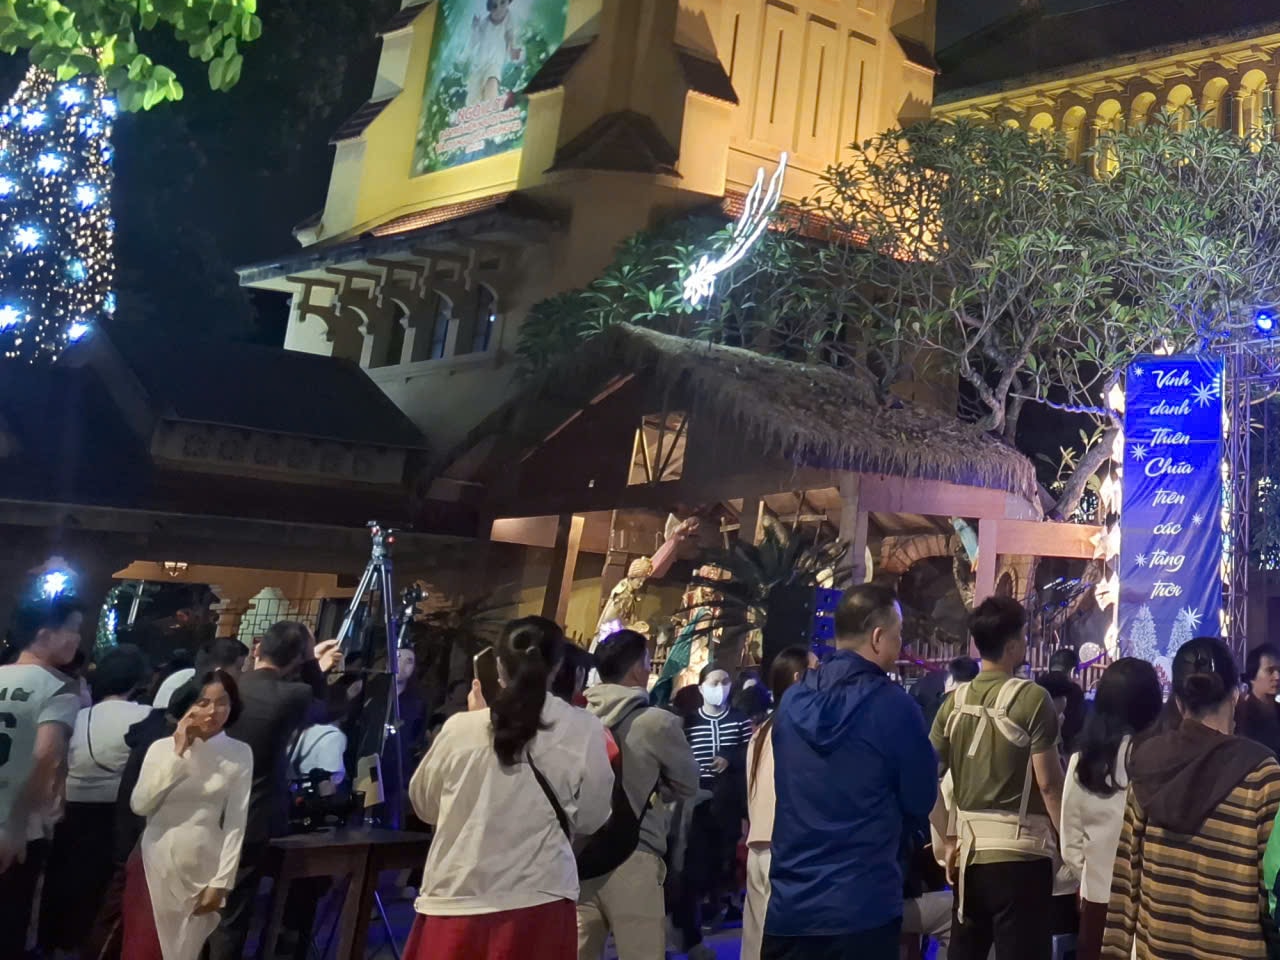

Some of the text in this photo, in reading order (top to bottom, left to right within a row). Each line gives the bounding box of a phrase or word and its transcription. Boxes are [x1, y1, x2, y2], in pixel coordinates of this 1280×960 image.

[1151, 369, 1192, 389] Vinh
[1149, 399, 1193, 415] danh
[1144, 457, 1195, 477] Chúa
[1153, 521, 1183, 535] các
